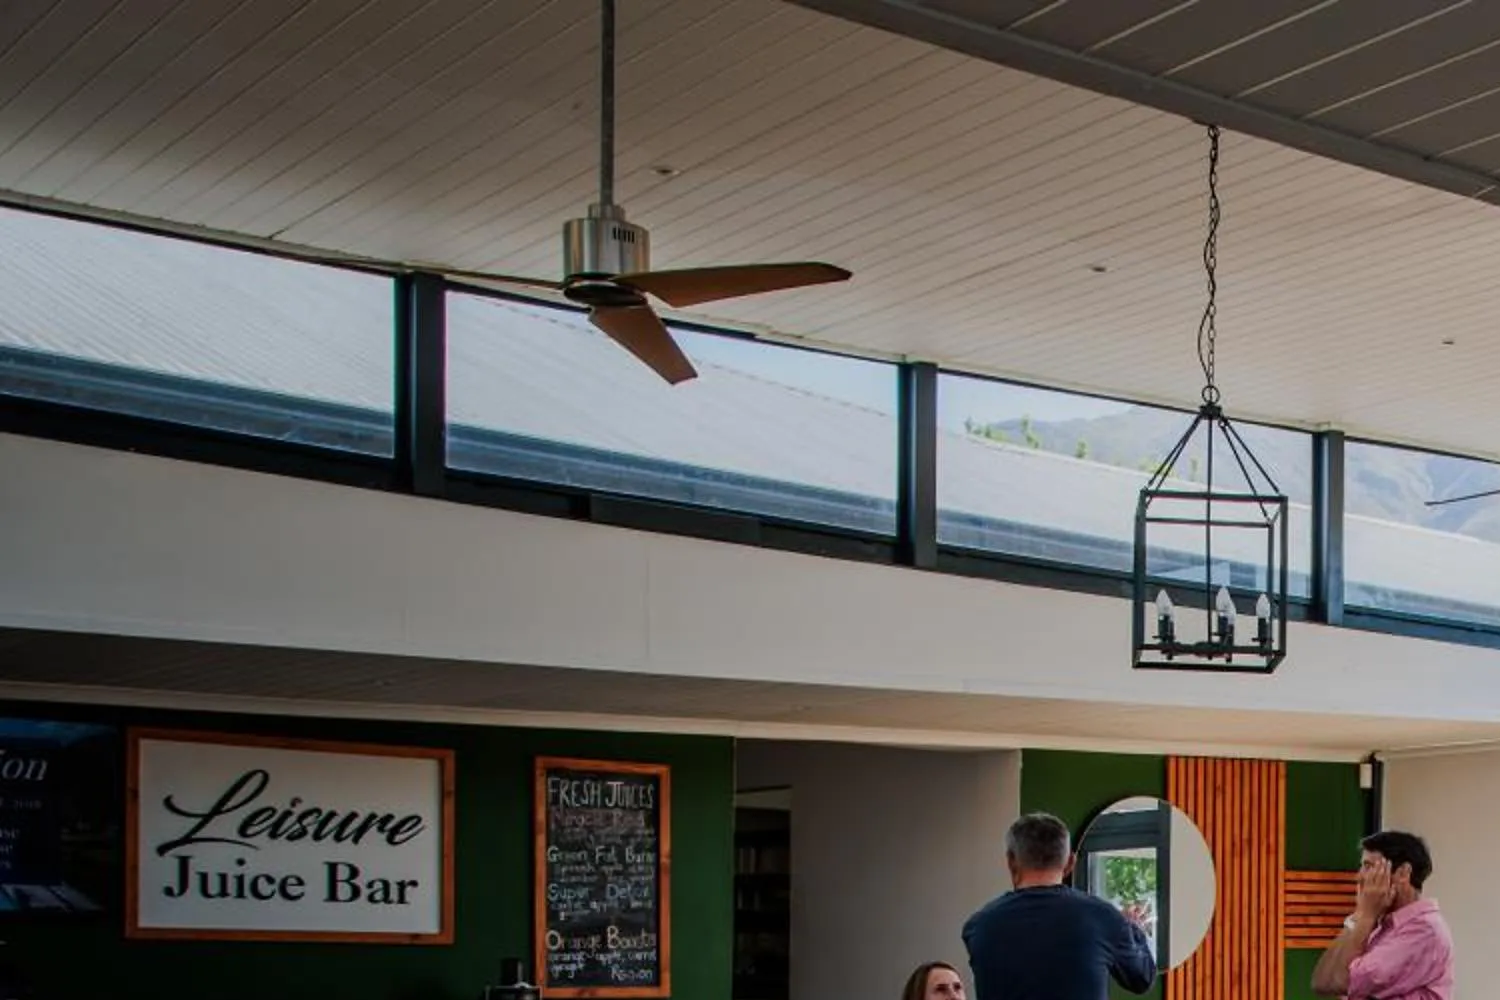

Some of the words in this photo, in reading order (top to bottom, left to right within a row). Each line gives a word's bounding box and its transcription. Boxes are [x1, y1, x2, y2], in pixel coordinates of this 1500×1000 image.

[0, 749, 48, 782] on
[156, 769, 425, 856] Leisure
[547, 777, 602, 807] FRESH
[604, 780, 655, 809] JUICES
[163, 855, 305, 901] Juice
[323, 862, 418, 905] Bar
